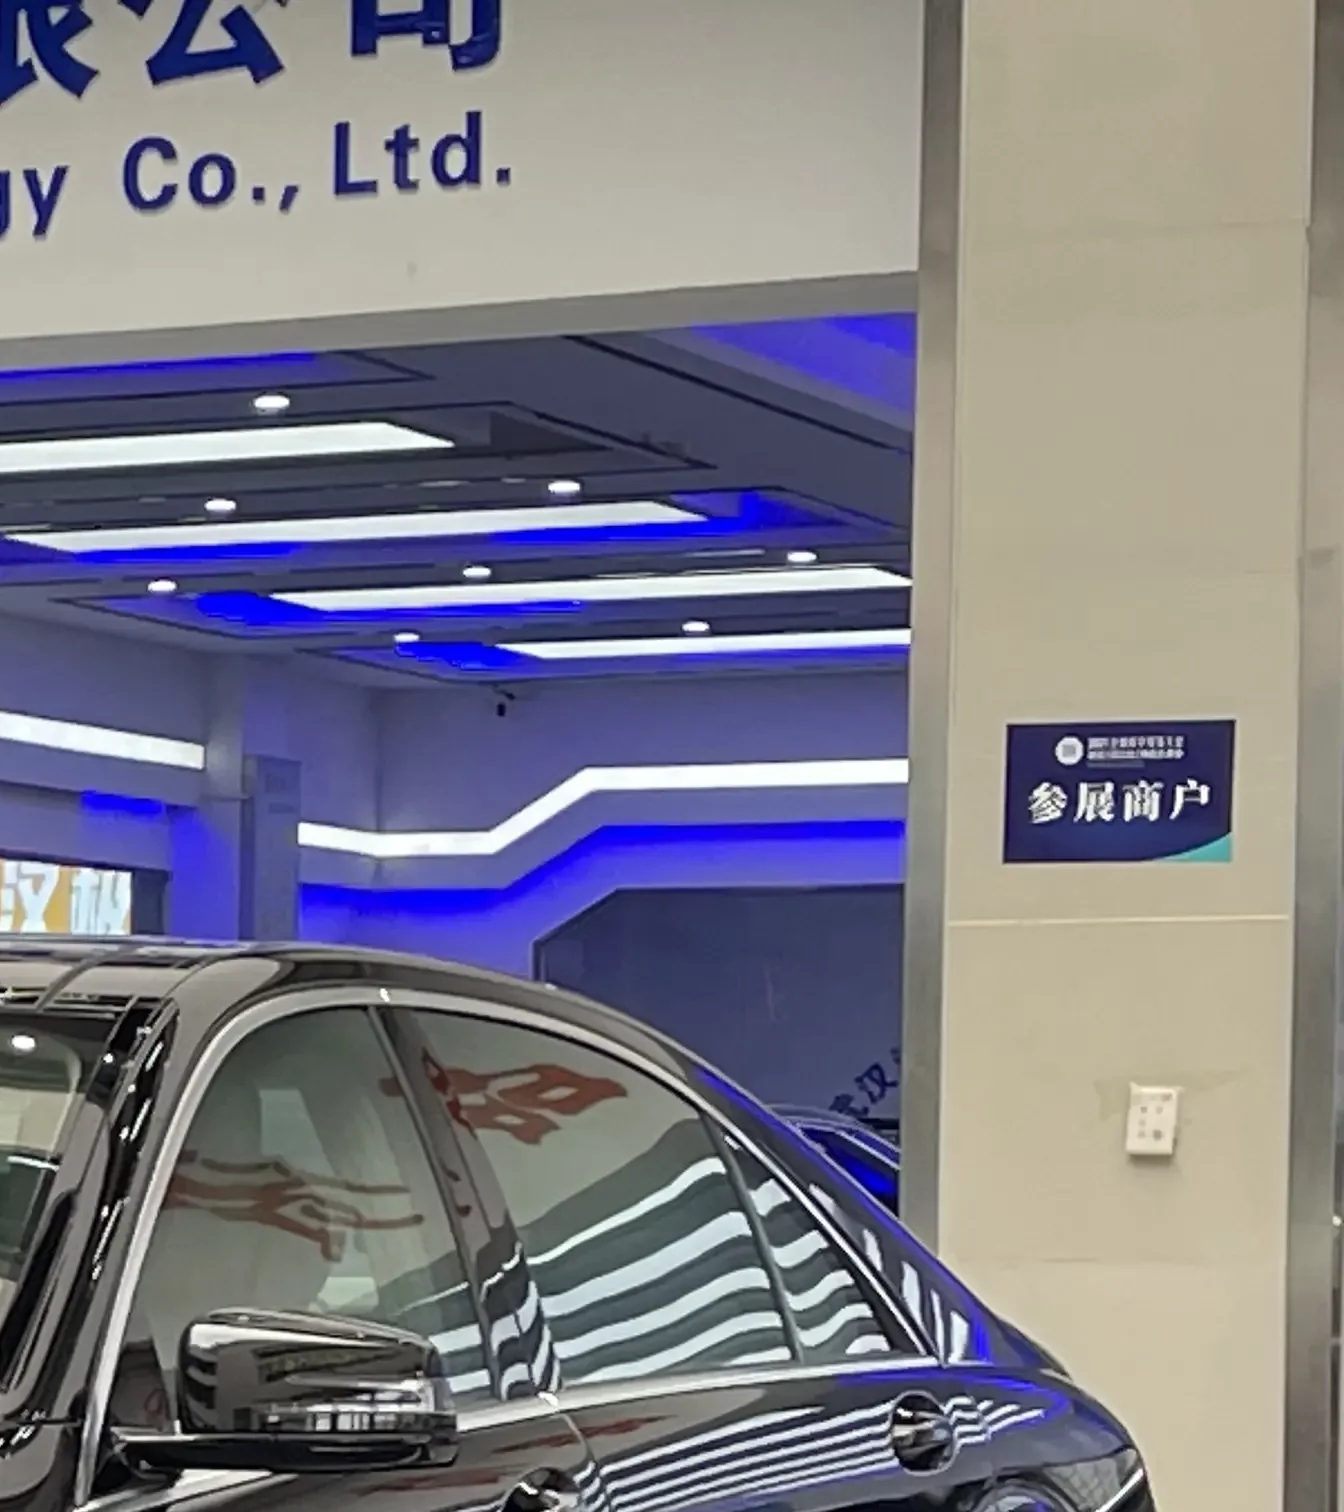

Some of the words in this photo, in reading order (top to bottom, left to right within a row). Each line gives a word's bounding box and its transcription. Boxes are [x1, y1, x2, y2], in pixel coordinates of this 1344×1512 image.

[121, 135, 298, 211] Co.,
[331, 110, 512, 197] Ltd.
[1027, 778, 1211, 824] 参展商户
